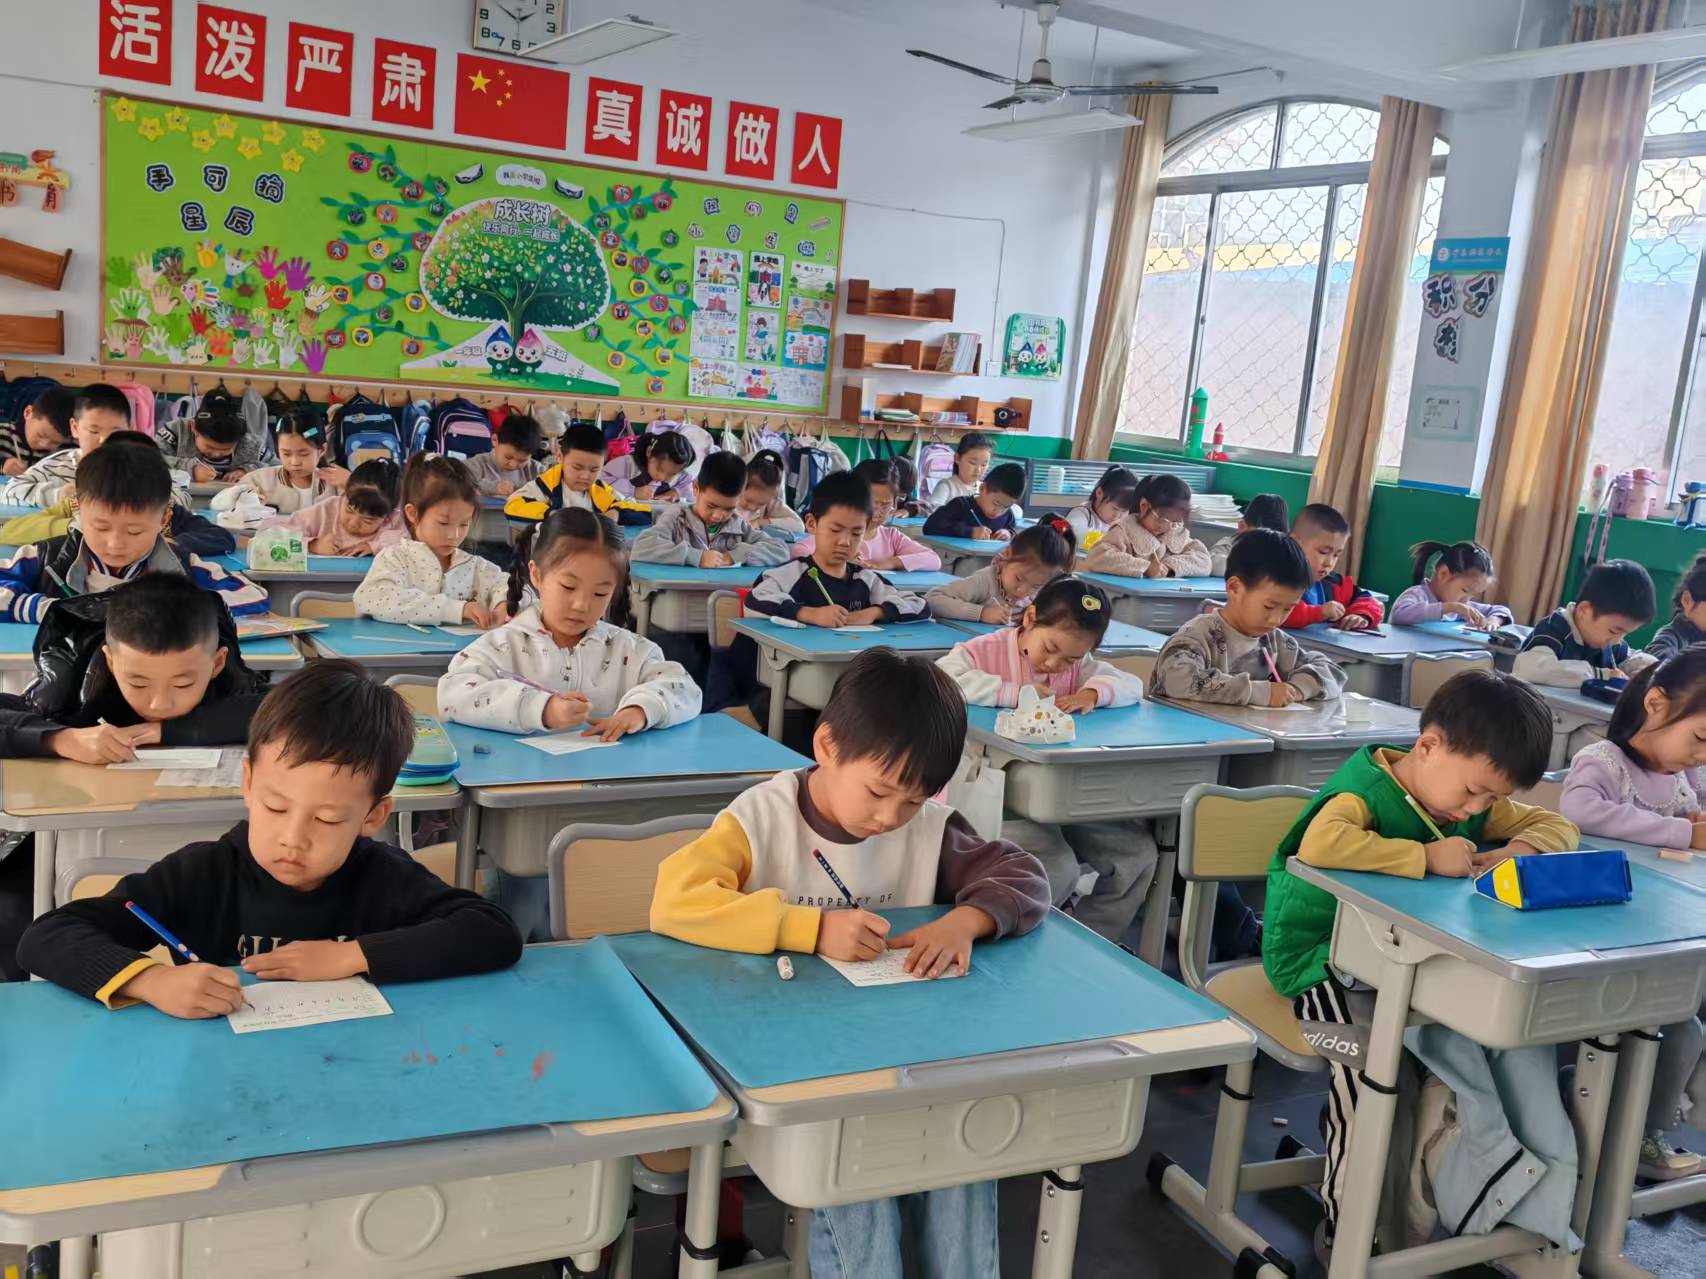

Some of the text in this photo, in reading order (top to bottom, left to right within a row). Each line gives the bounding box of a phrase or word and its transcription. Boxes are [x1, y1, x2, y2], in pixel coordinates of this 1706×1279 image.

[480, 8, 489, 19] 9
[546, 3, 555, 14] 2
[481, 27, 490, 38] 8
[546, 22, 556, 33] 3
[110, 0, 426, 112] 活泼严肃
[511, 39, 521, 50] 6
[592, 89, 832, 175] 真诚做人
[149, 166, 282, 201] 手可摘
[182, 203, 254, 234] 星辰
[494, 199, 551, 226] 成长树
[1303, 1032, 1359, 1056] didas
